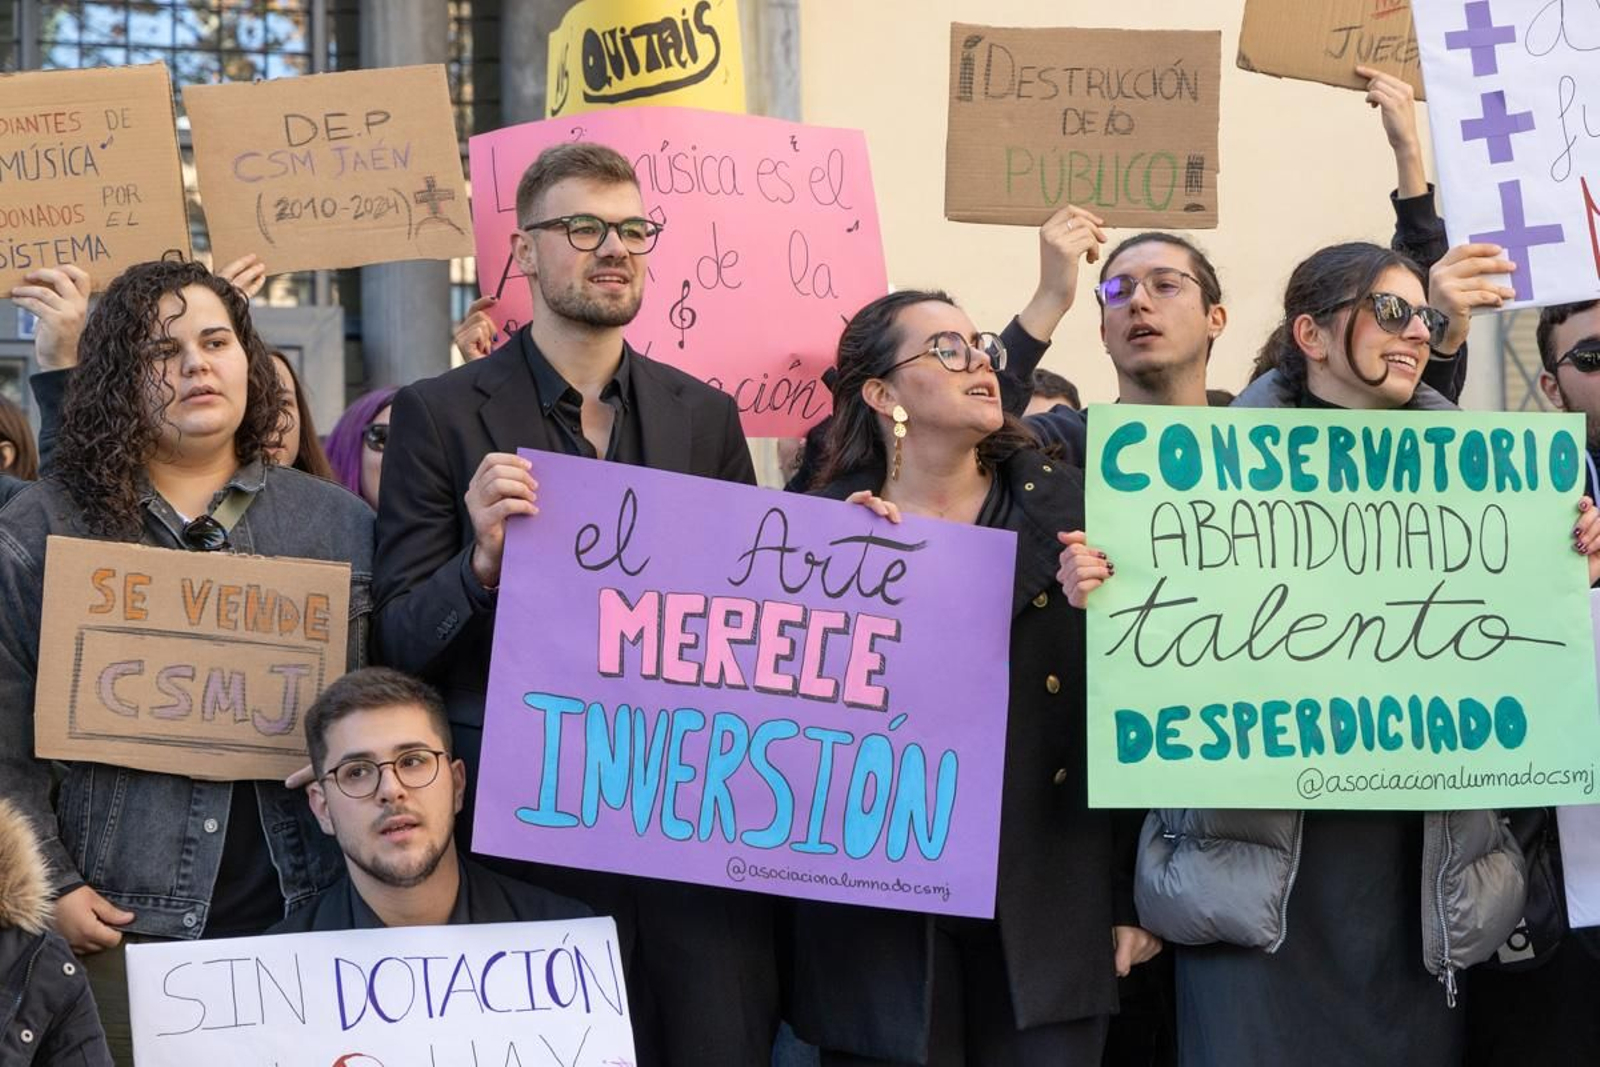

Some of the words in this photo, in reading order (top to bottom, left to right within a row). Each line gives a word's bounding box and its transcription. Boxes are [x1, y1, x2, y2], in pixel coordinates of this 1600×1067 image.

[104, 108, 133, 131] DE
[1062, 107, 1099, 136] DE
[102, 183, 142, 207] POR
[232, 150, 316, 183] CSM
[330, 138, 411, 178] JAÉN
[756, 157, 795, 204] es
[809, 148, 852, 210] el
[106, 211, 139, 228] EL
[697, 221, 742, 290] de
[788, 229, 838, 299] la
[1100, 421, 1580, 493] CONSERVATORIO
[573, 487, 651, 576] el
[726, 507, 928, 606] Arte
[1150, 499, 1509, 575] ABANDONADO
[88, 568, 152, 621] SE
[181, 577, 331, 644] VENDE
[1104, 575, 1567, 668] talento
[597, 586, 902, 713] MERECE
[96, 658, 313, 737] CSMJ
[1115, 694, 1528, 765] DESPERDICIADO
[513, 690, 959, 862] INVERSIÓN
[1296, 761, 1595, 800] @asociacionalumnadocsmj
[726, 856, 951, 902] @asociacionalumnadocsmj
[157, 953, 306, 1037] SIN
[334, 932, 625, 1032] DOTACIÓN
